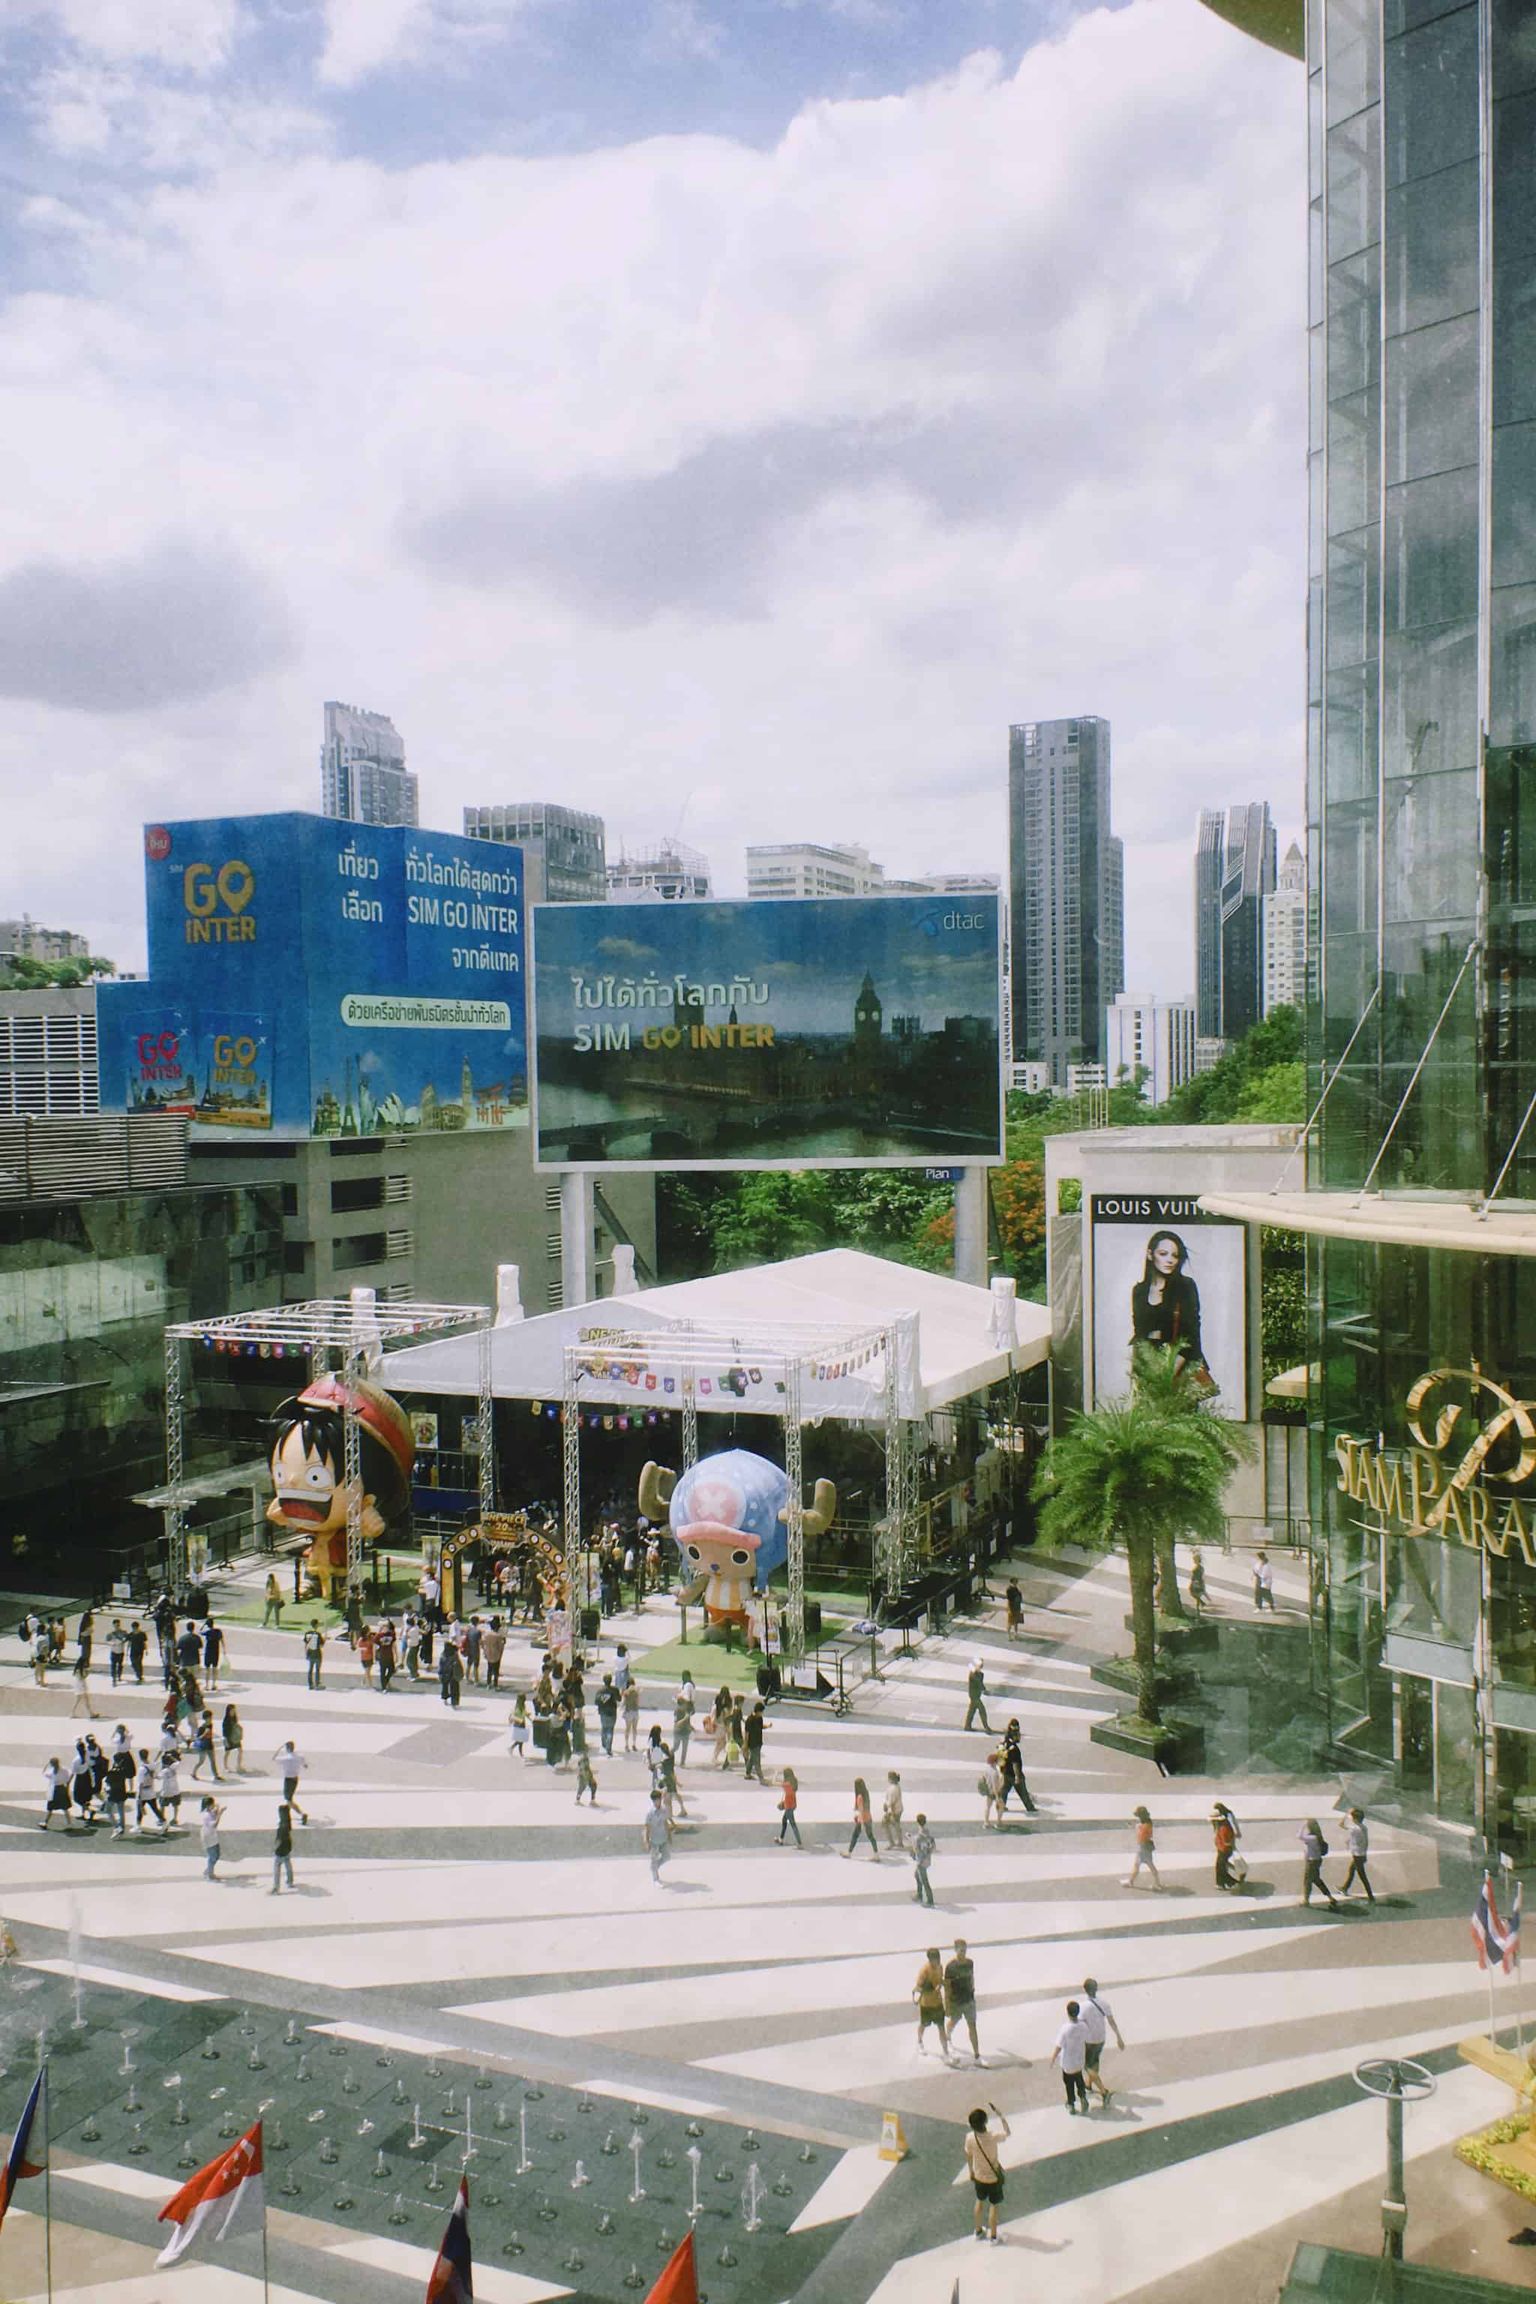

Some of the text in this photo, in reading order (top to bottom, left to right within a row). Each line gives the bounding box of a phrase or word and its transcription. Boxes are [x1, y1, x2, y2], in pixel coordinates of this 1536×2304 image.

[338, 840, 518, 900] เที่ยว ทั่วโลกได้สุดกว่า
[183, 860, 254, 917] GO
[342, 890, 518, 934] เลือก SIM GO INTER
[943, 911, 984, 930] dtac
[185, 916, 256, 944] INTER
[452, 943, 519, 972] จากดีแทค
[571, 971, 769, 1009] ไปได้ทั่วโลกกับ
[138, 1031, 180, 1066] GO
[214, 1035, 257, 1068] GO
[573, 1023, 776, 1052] SIM GO INTER
[141, 1063, 182, 1081] INTER
[214, 1067, 257, 1086] INTER
[925, 1168, 950, 1180] Plan
[1097, 1200, 1151, 1216] LOUIS
[1334, 1433, 1536, 1569] SIAM PARA
